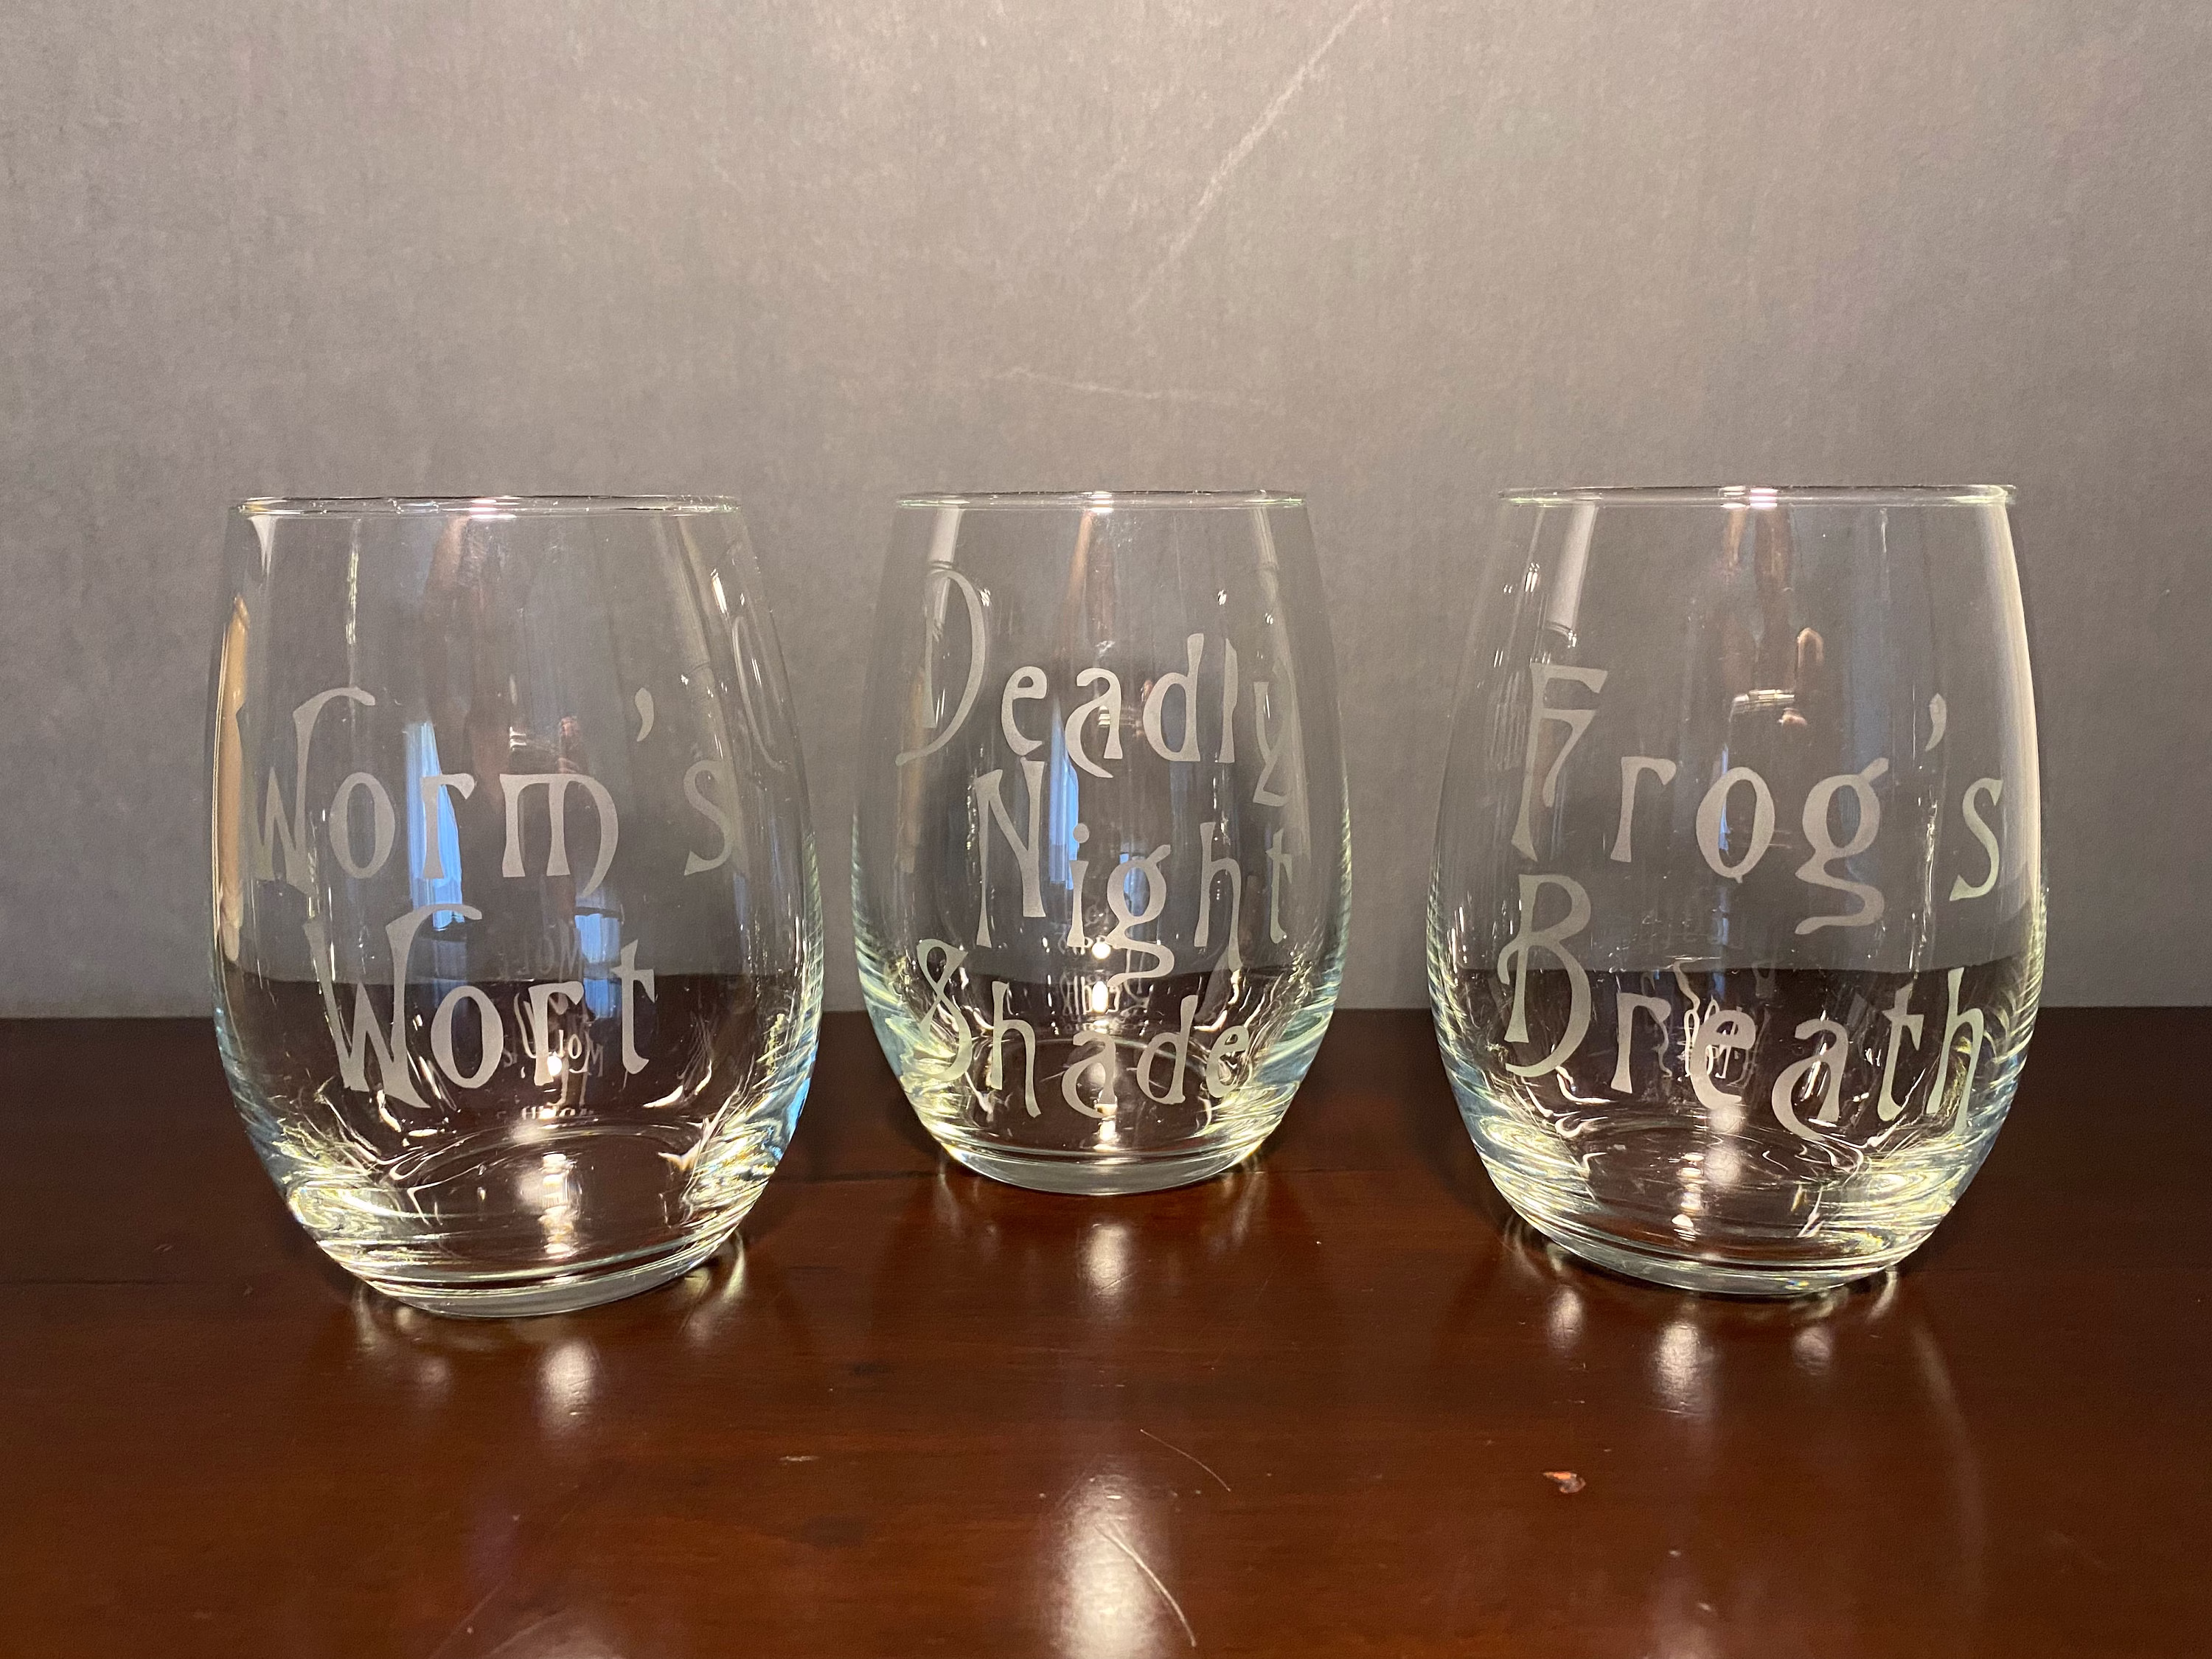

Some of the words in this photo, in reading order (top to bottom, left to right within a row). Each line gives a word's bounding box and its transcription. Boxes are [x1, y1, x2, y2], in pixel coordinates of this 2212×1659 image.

[236, 687, 734, 899] Worm's
[895, 569, 1295, 807] Deadly
[1511, 662, 2003, 935] Frog's
[974, 757, 1293, 987] Night
[303, 903, 655, 1108] Wort
[913, 939, 1249, 1119] Shade
[1497, 874, 1985, 1141] Breath
